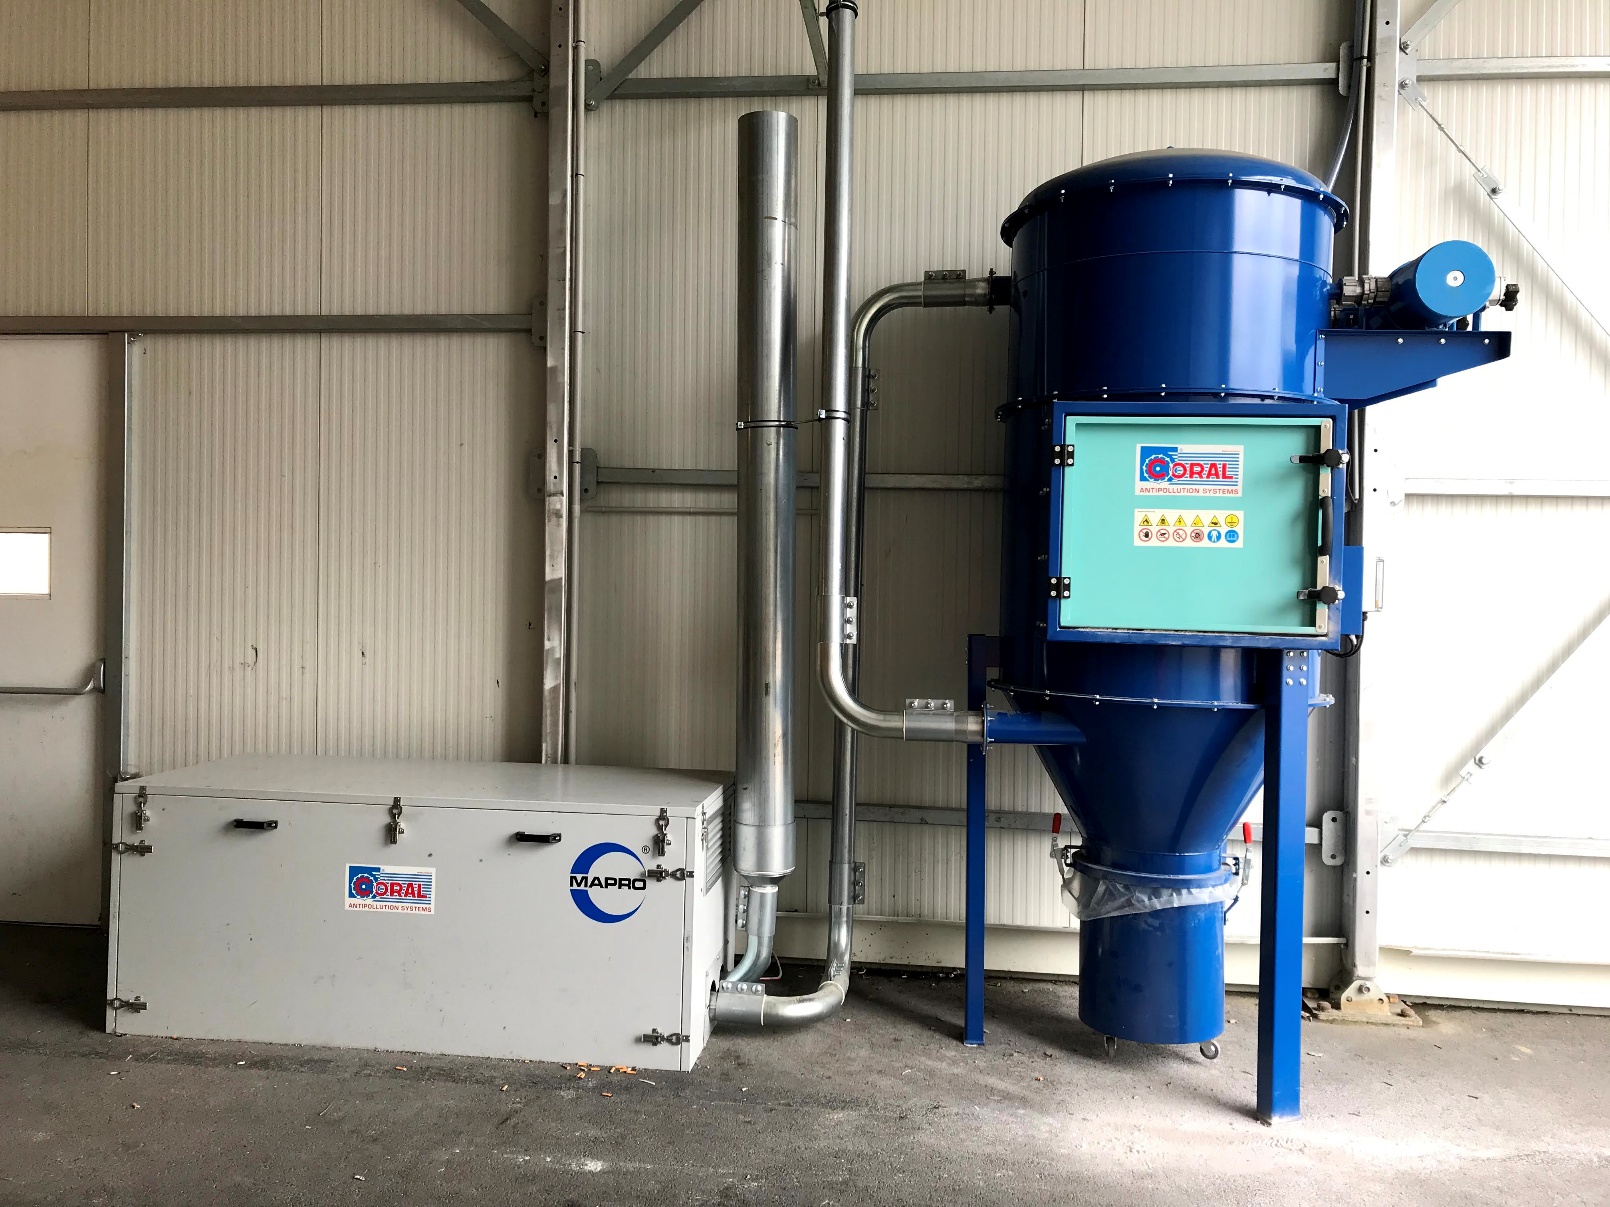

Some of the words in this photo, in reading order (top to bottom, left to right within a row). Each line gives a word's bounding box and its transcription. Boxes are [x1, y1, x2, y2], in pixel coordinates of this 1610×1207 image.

[1147, 458, 1234, 479] CORAL
[355, 877, 428, 899] CORAL
[570, 876, 647, 890] MAPRO
[348, 903, 399, 911] ANTIPOLLUTION
[401, 905, 431, 913] SYSTEMS
